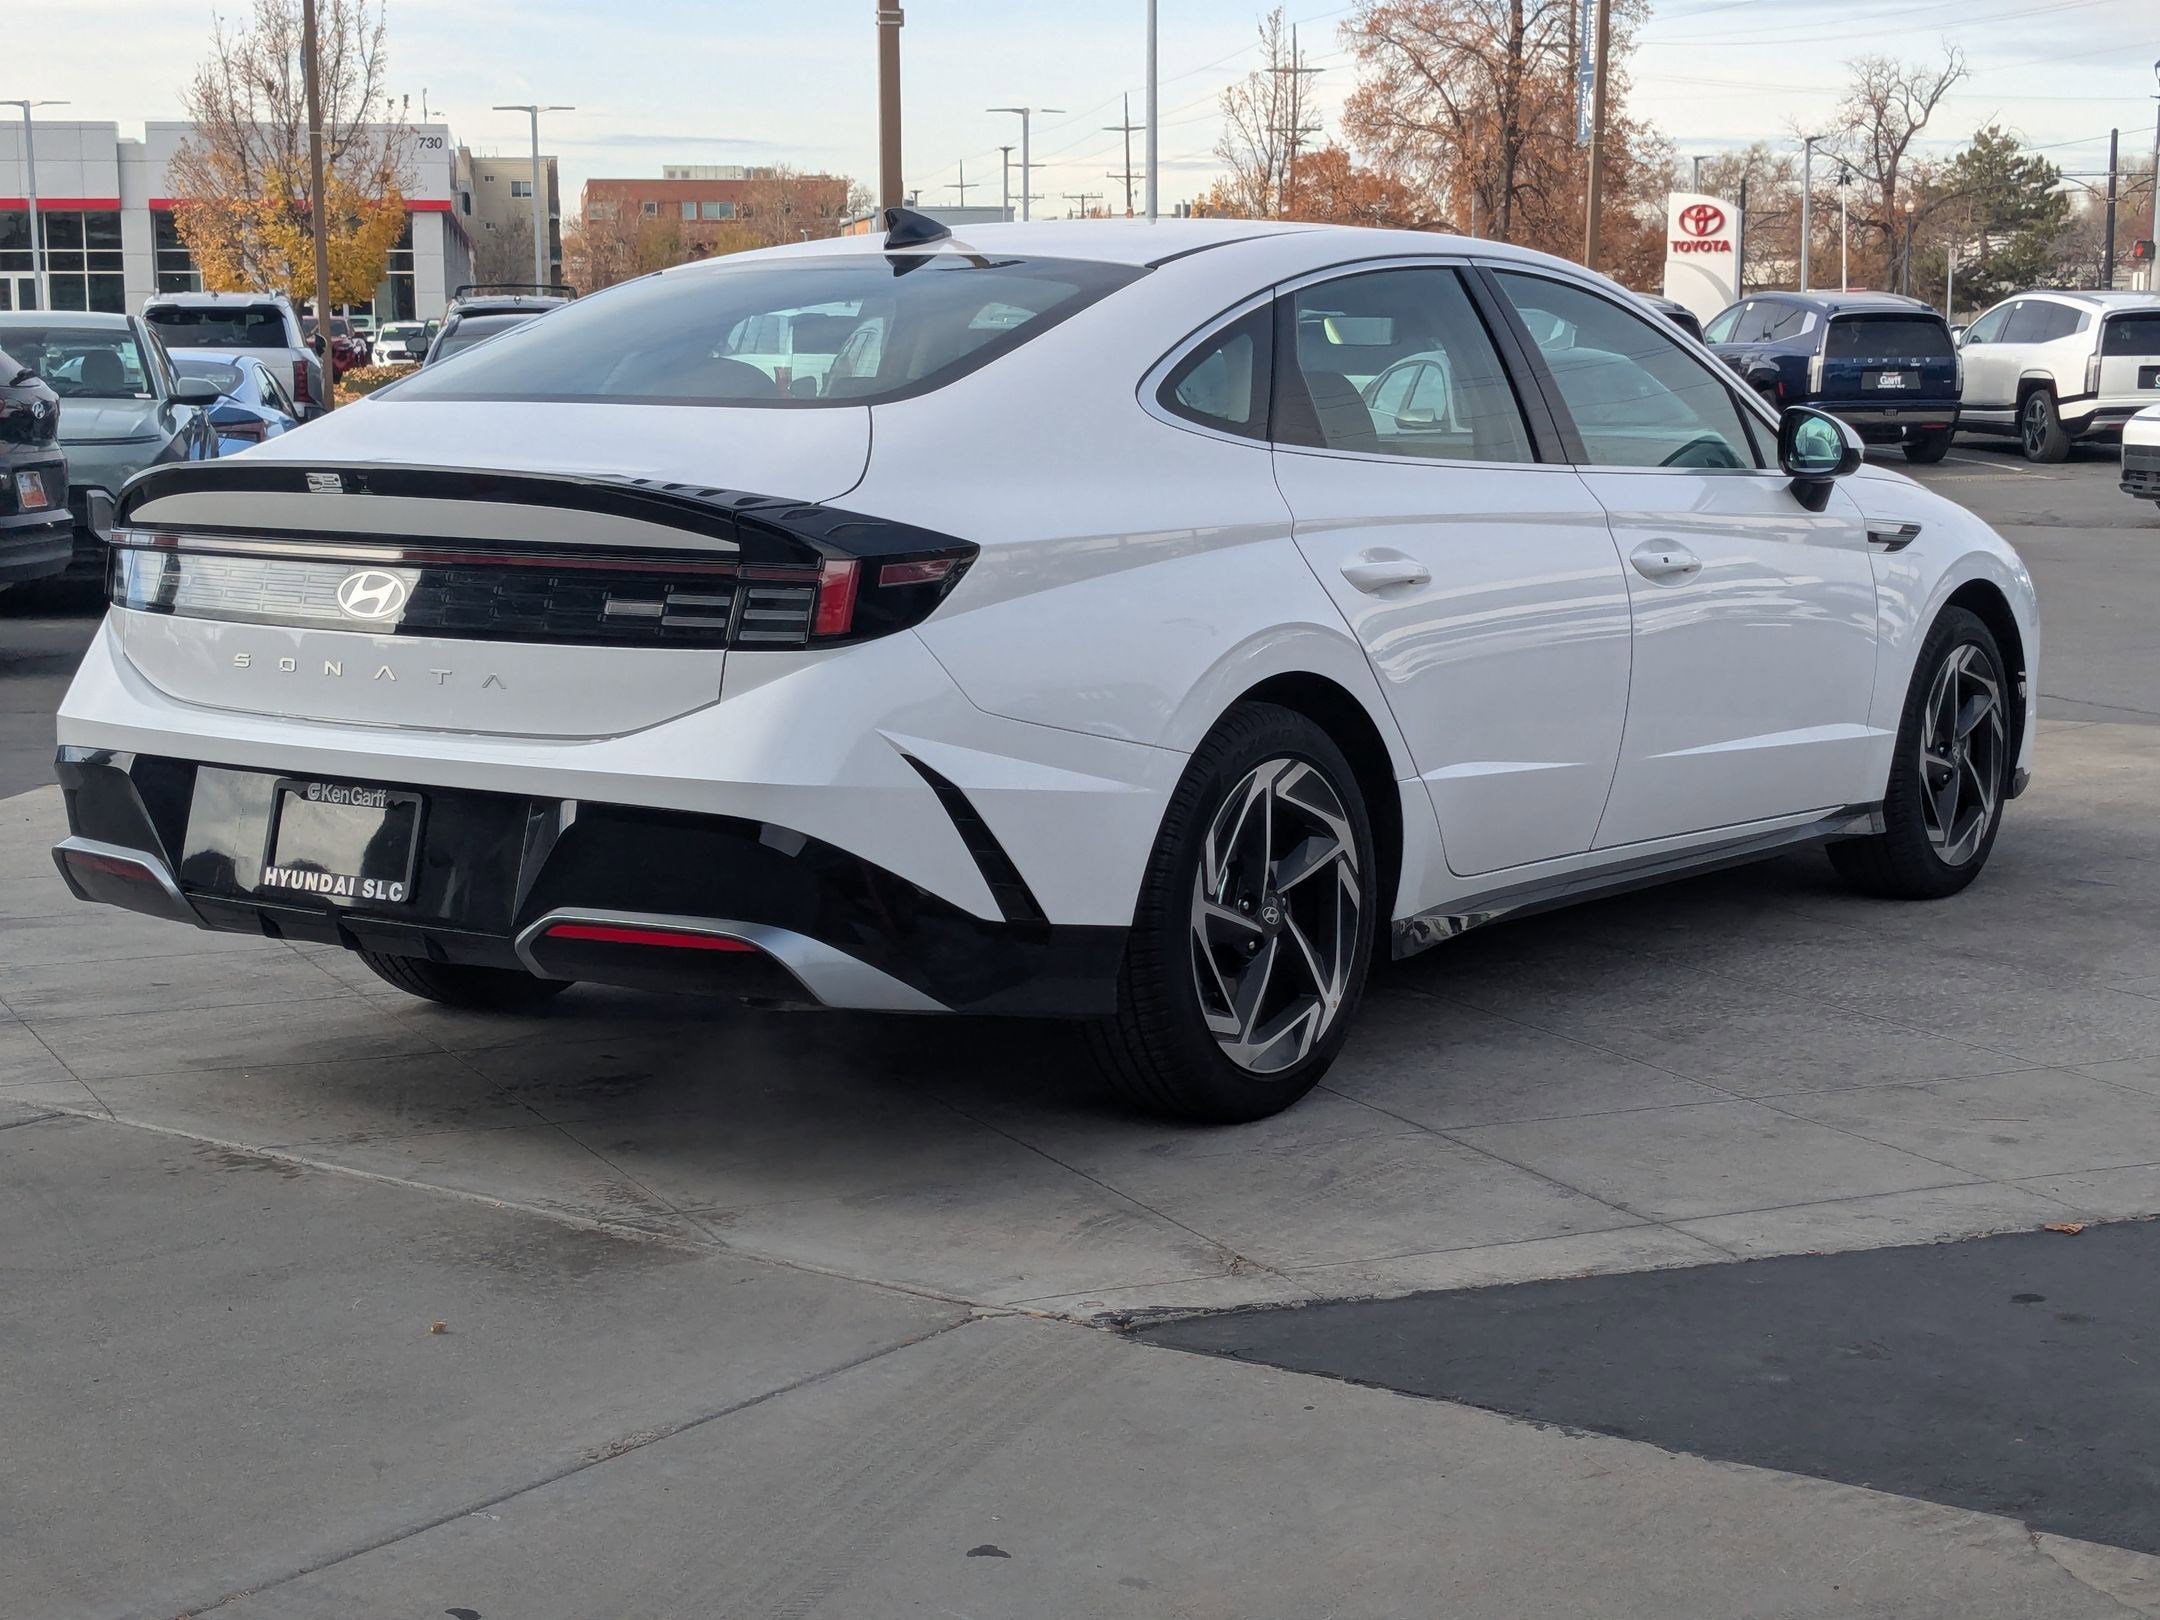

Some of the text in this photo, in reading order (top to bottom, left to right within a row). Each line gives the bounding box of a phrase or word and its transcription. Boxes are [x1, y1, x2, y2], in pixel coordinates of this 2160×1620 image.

[419, 136, 443, 149] 730
[1670, 240, 1732, 253] TOYOTA
[233, 652, 507, 690] SONATA
[321, 783, 387, 808] Ken Garff
[263, 866, 404, 902] HYUNDAI SLC
